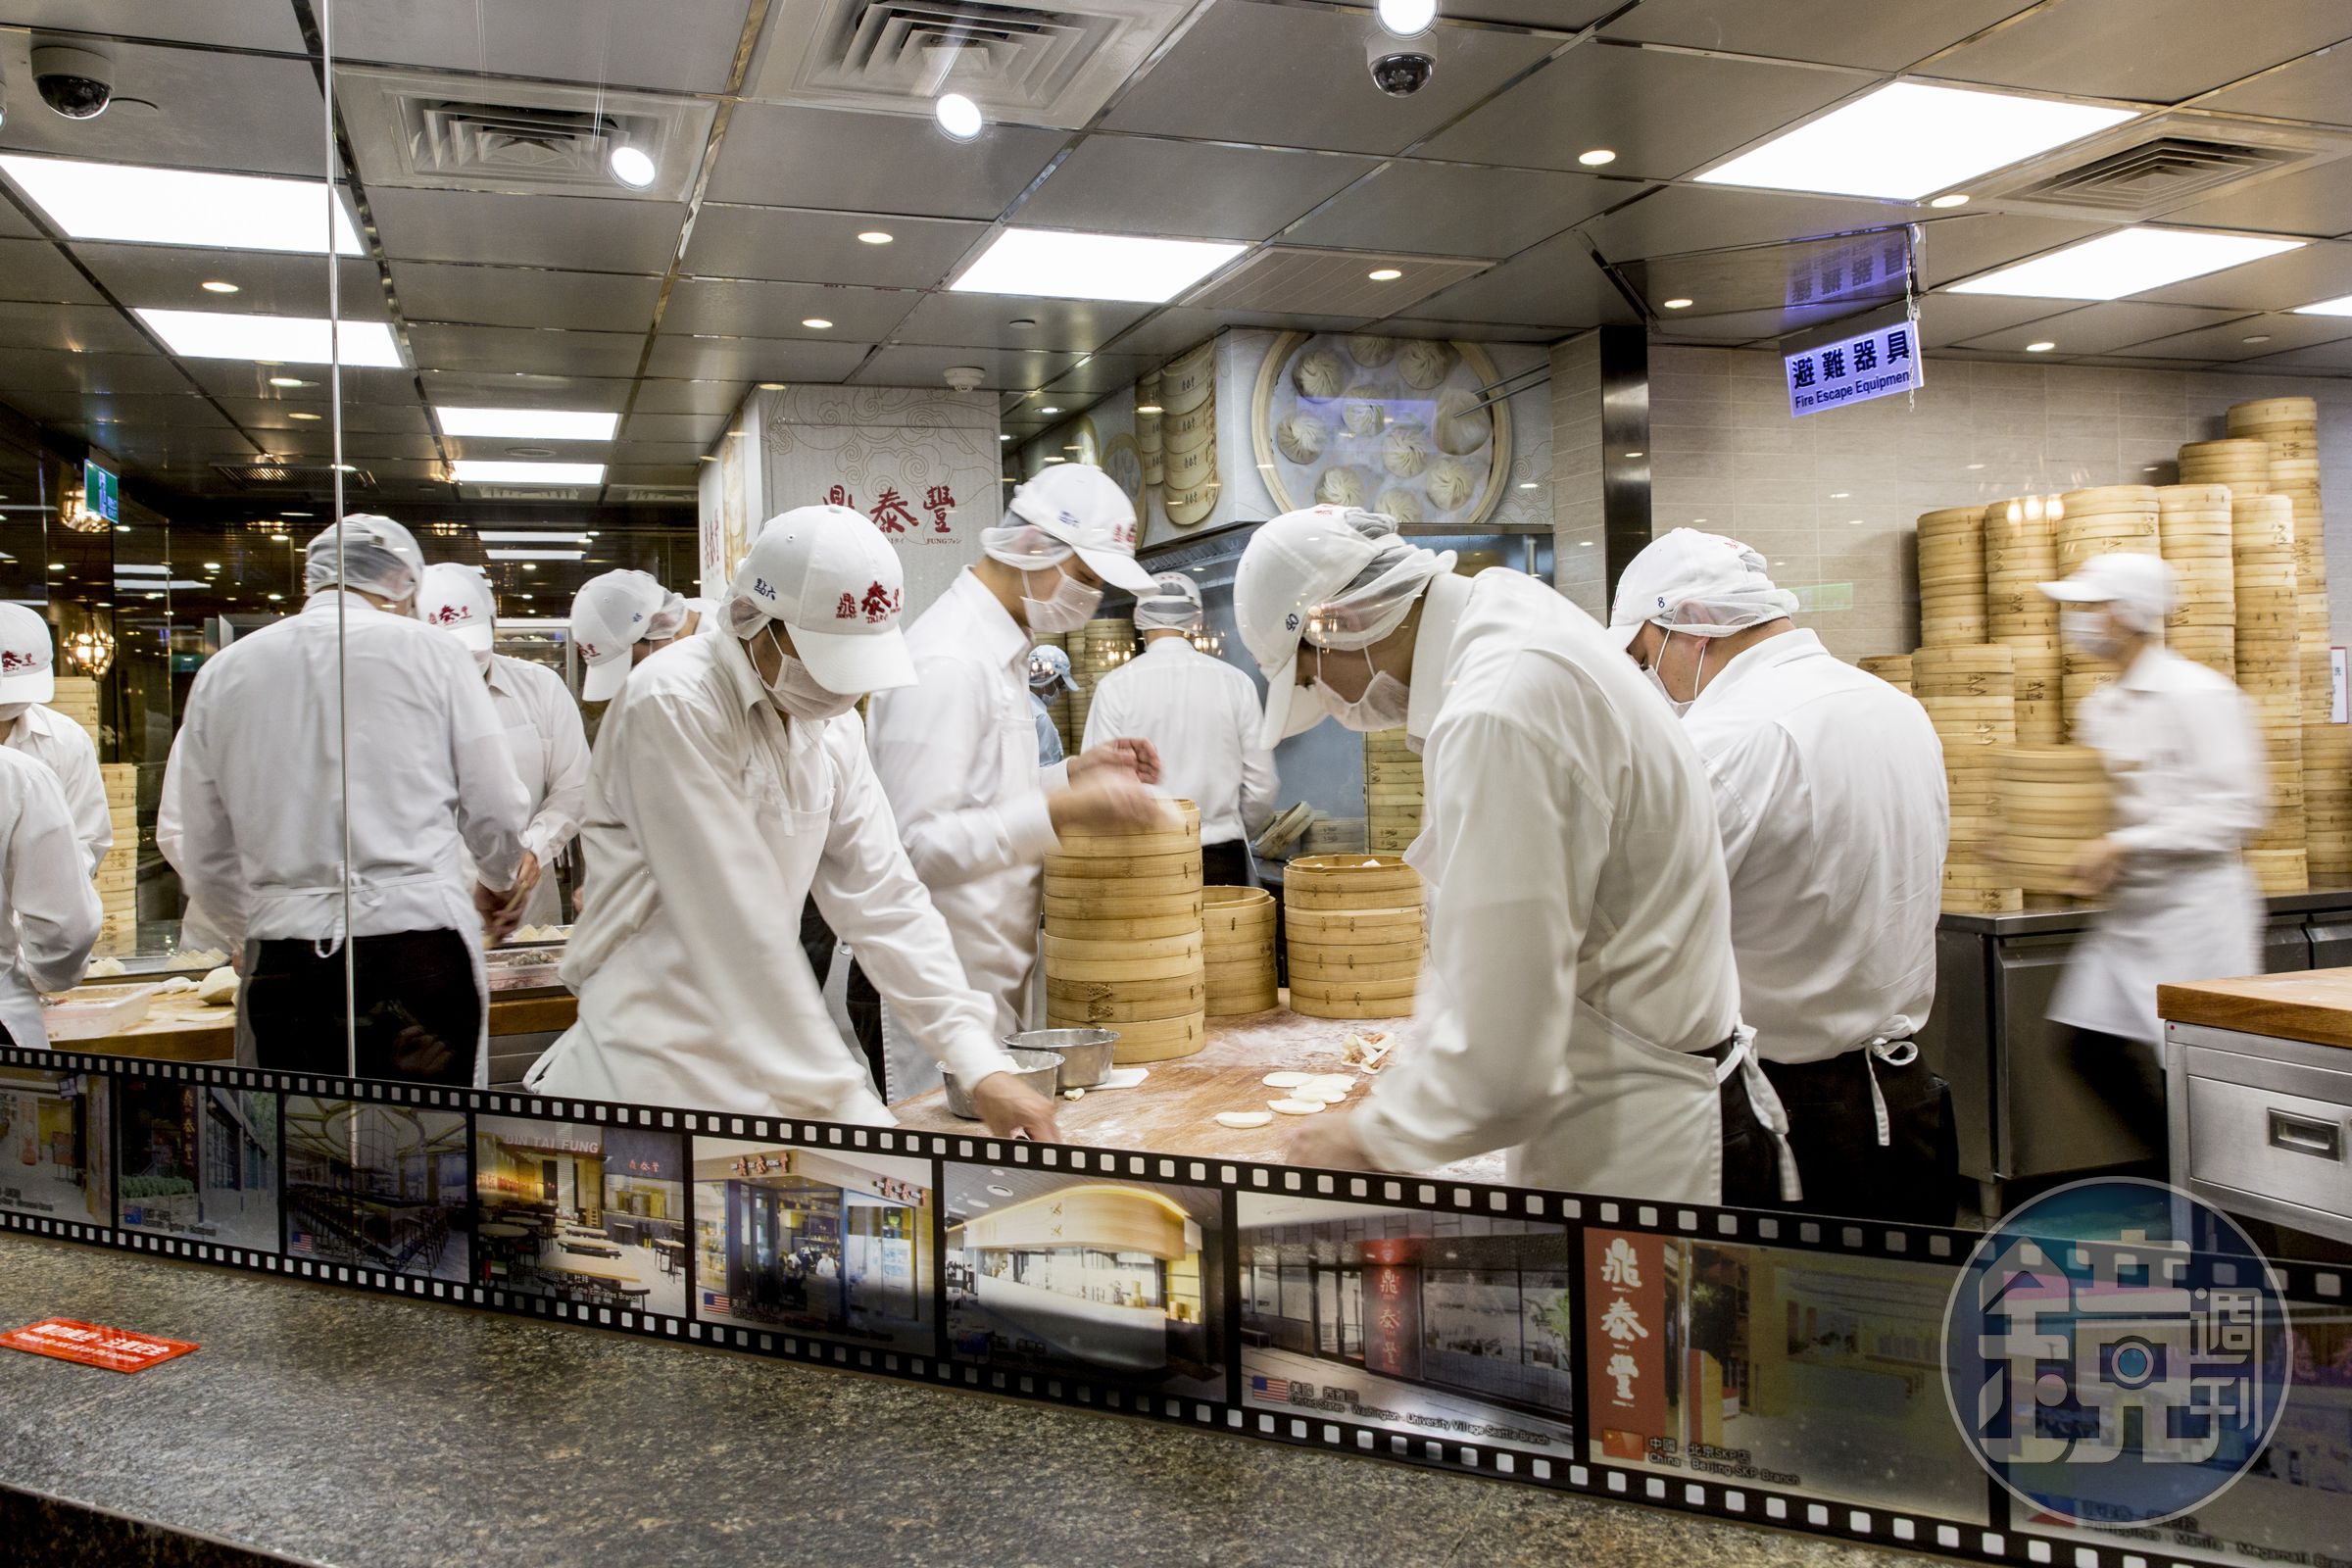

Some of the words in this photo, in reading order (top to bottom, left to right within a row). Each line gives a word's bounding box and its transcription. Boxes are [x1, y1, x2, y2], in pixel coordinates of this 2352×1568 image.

[1792, 330, 1909, 389] 避難器具
[1795, 395, 1814, 408] Fire
[1817, 384, 1852, 404] Escape
[1657, 597, 1665, 609] 8
[506, 1134, 528, 1146] DIN
[532, 1136, 555, 1149] TAI
[562, 1140, 601, 1153] FUNG
[1291, 1396, 1317, 1409] United
[1318, 1399, 1345, 1413] States
[1351, 1403, 1399, 1421] Washington
[1406, 1413, 1450, 1430] University
[1452, 1420, 1484, 1436] Village
[1487, 1425, 1517, 1440] Seattle
[1520, 1431, 1549, 1445] Branch
[1650, 1437, 1677, 1452] 中國
[1649, 1452, 1681, 1467] China
[1692, 1459, 1732, 1476] Beijing
[1735, 1465, 1759, 1478] SKP
[1762, 1469, 1799, 1485] Branch
